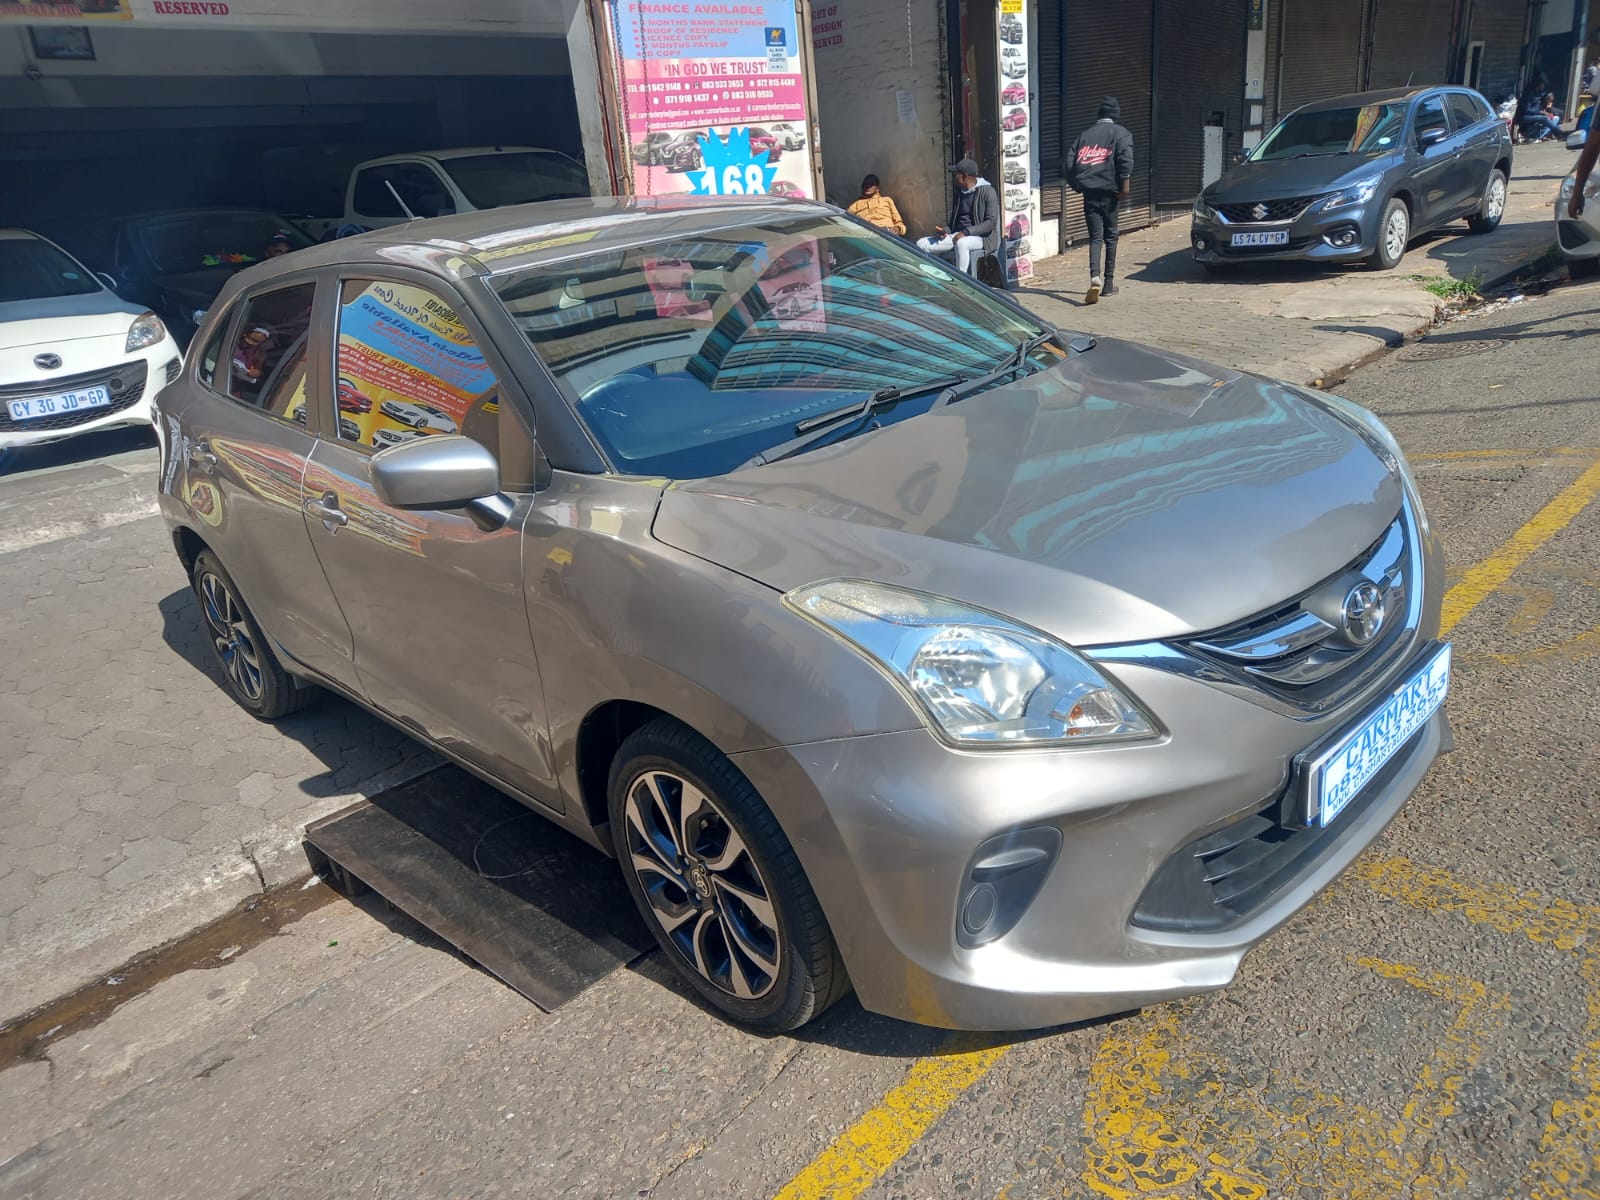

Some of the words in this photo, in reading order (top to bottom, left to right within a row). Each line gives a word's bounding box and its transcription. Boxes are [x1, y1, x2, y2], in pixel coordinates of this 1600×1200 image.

[154, 0, 229, 16] RESERVED
[694, 5, 764, 15] AVAILABLE
[683, 63, 708, 76] GOD
[710, 62, 728, 75] WE
[700, 163, 766, 195] 168
[12, 401, 31, 417] CY
[37, 398, 55, 413] 30
[61, 394, 79, 410] JD
[87, 389, 105, 405] GP
[1346, 664, 1434, 770] CARMART
[1368, 717, 1402, 763] 533
[1406, 671, 1447, 724] 3653
